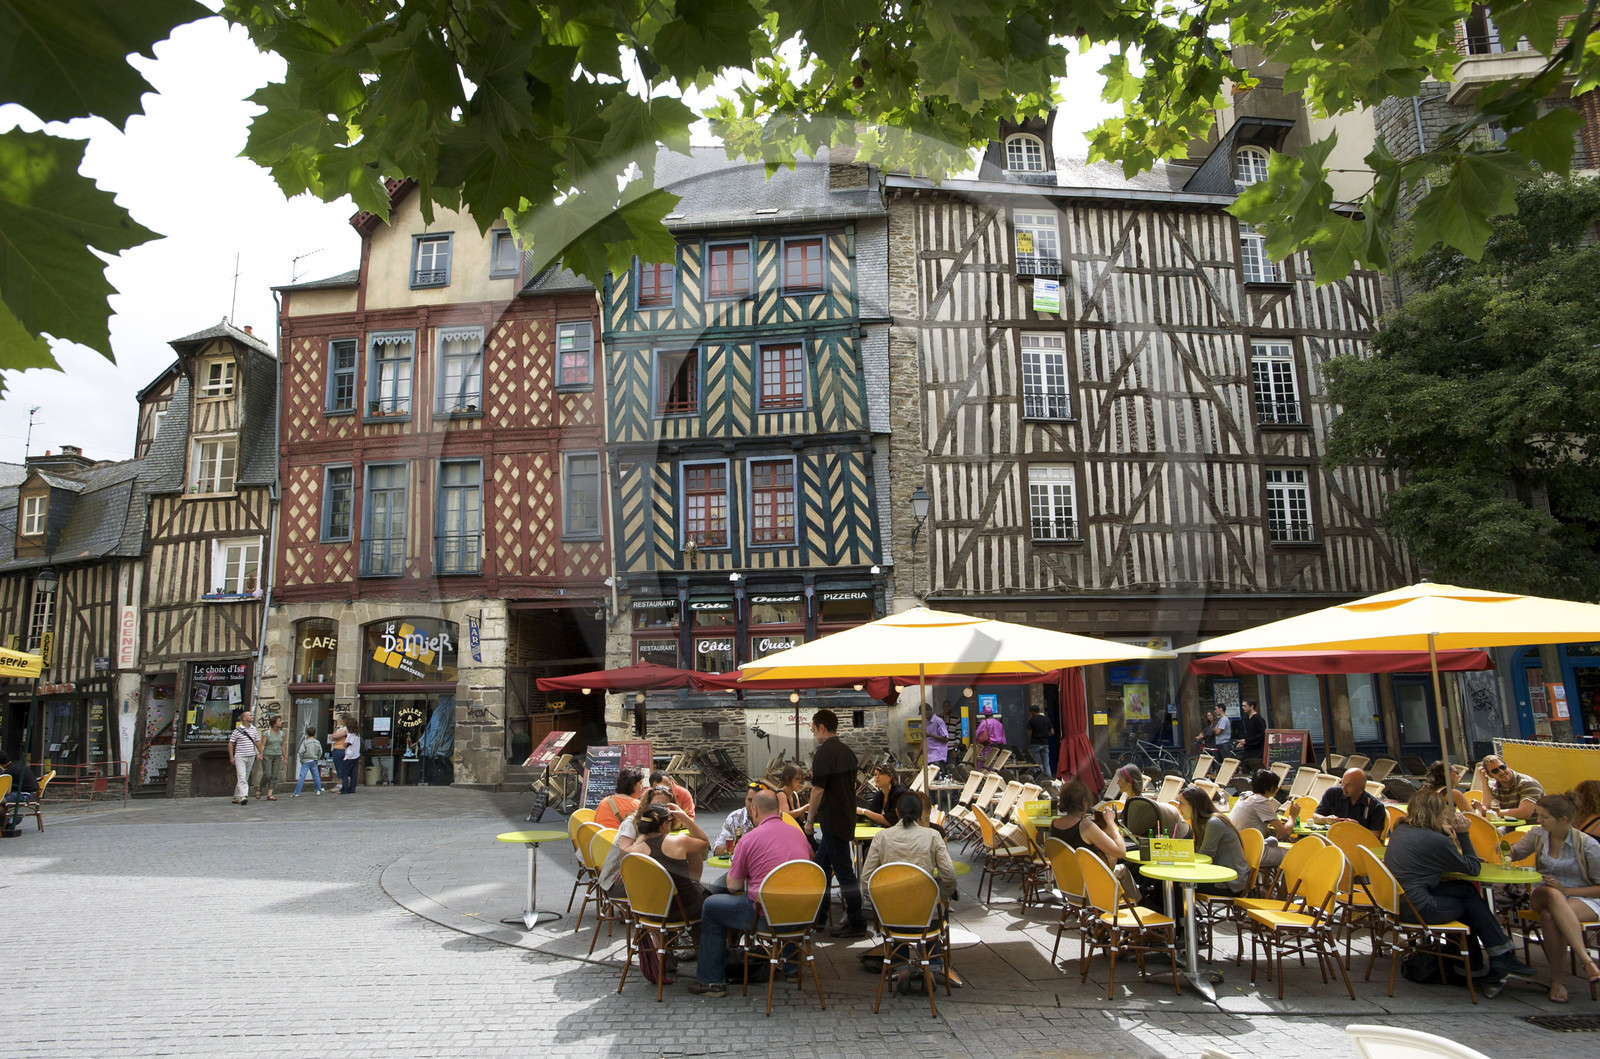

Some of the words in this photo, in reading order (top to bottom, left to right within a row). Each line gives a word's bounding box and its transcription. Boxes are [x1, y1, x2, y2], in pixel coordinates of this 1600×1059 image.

[751, 595, 801, 603] Ouest
[823, 591, 868, 600] PIZZERIA
[633, 600, 676, 608] RESTAURANT
[385, 622, 396, 634] le
[470, 619, 479, 644] BAR
[121, 610, 135, 664] AGENCE
[302, 636, 337, 650] CAFE
[698, 640, 732, 654] Côte
[759, 638, 797, 652] Ouest
[402, 658, 413, 666] BAR
[194, 665, 204, 674] Le
[205, 664, 226, 674] choix
[227, 664, 245, 673] d'Isa
[400, 664, 426, 679] BRASSERIE
[398, 708, 423, 717] SALLES
[1154, 842, 1173, 850] Café
